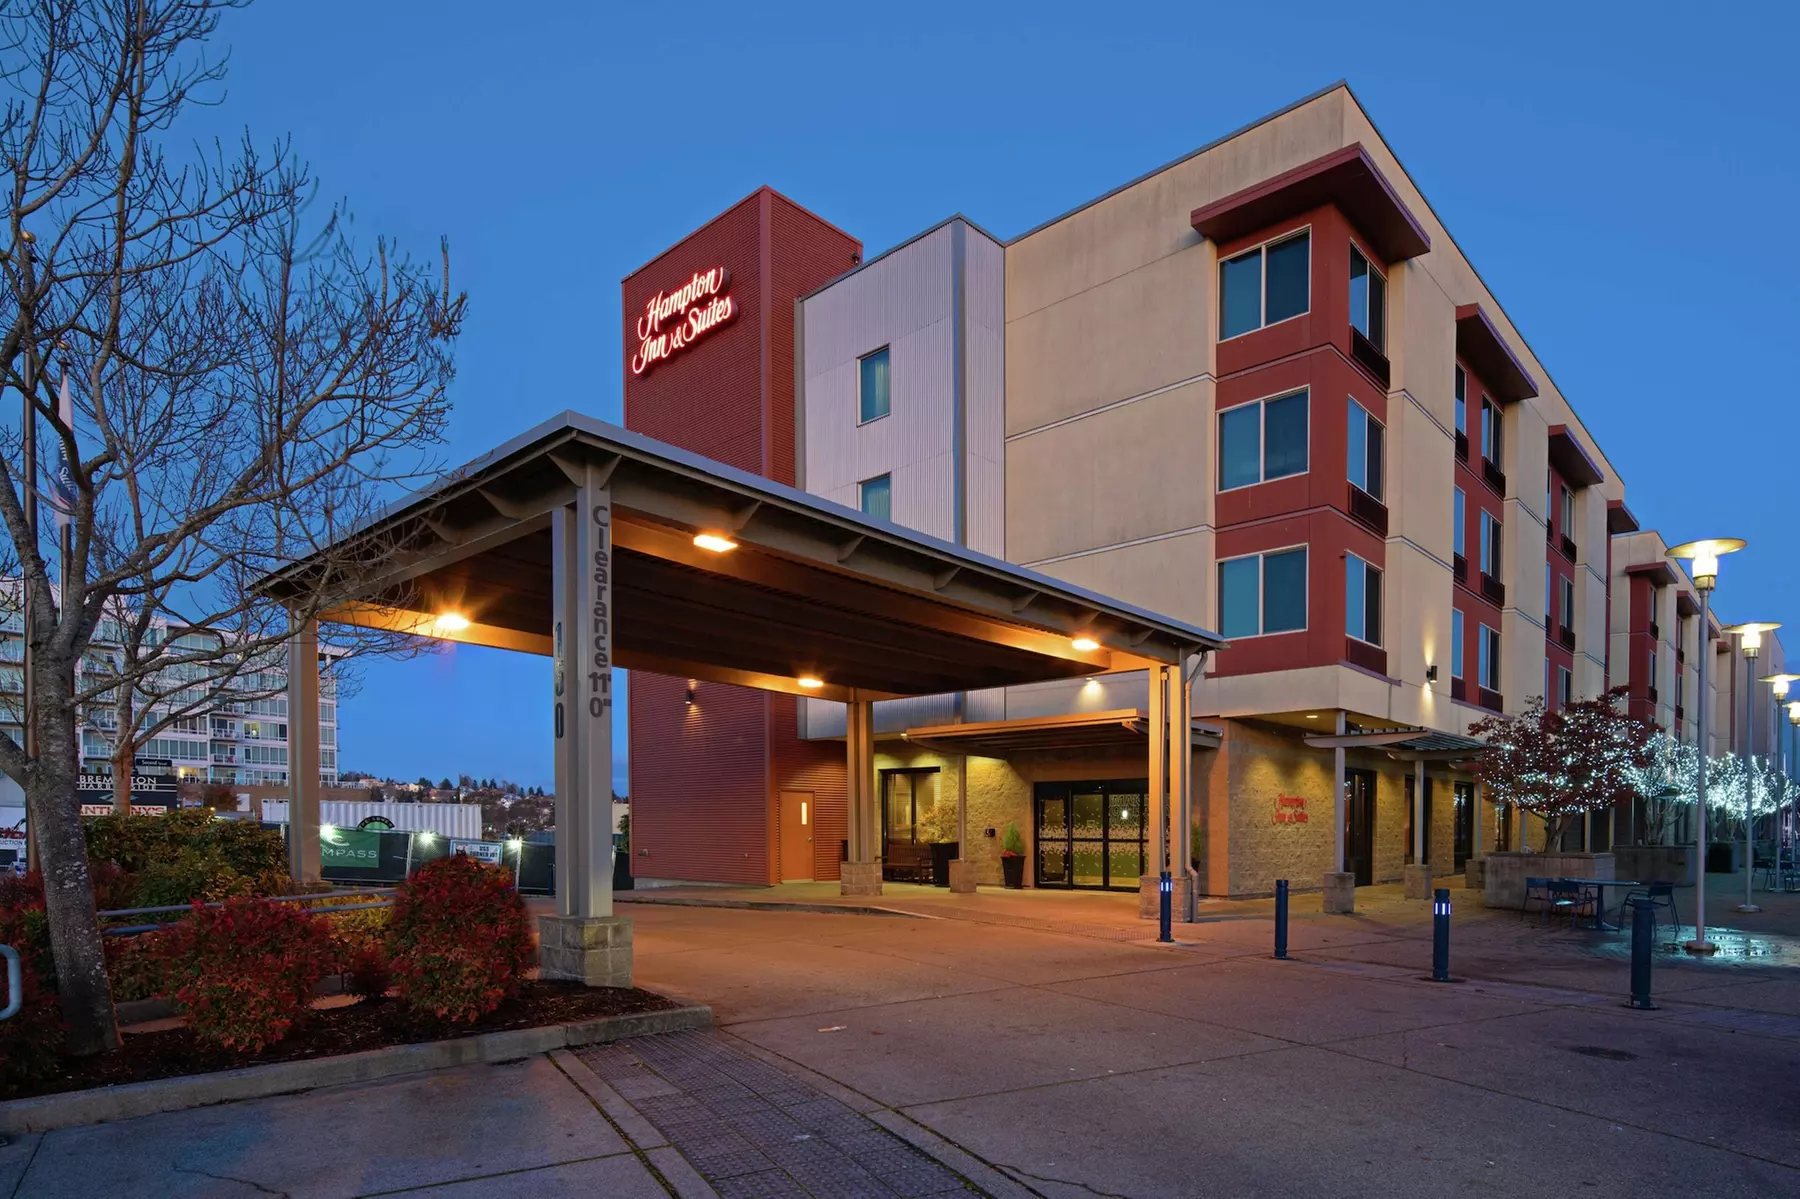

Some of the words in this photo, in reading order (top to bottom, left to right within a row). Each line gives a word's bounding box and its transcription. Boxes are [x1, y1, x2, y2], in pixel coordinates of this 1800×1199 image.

[632, 335, 673, 374] Inn
[673, 326, 685, 348] &
[683, 296, 732, 341] Suites
[638, 267, 724, 340] Hampton
[593, 505, 609, 669] Clearance
[80, 775, 157, 784] BREMTON
[322, 849, 377, 858] MPASS
